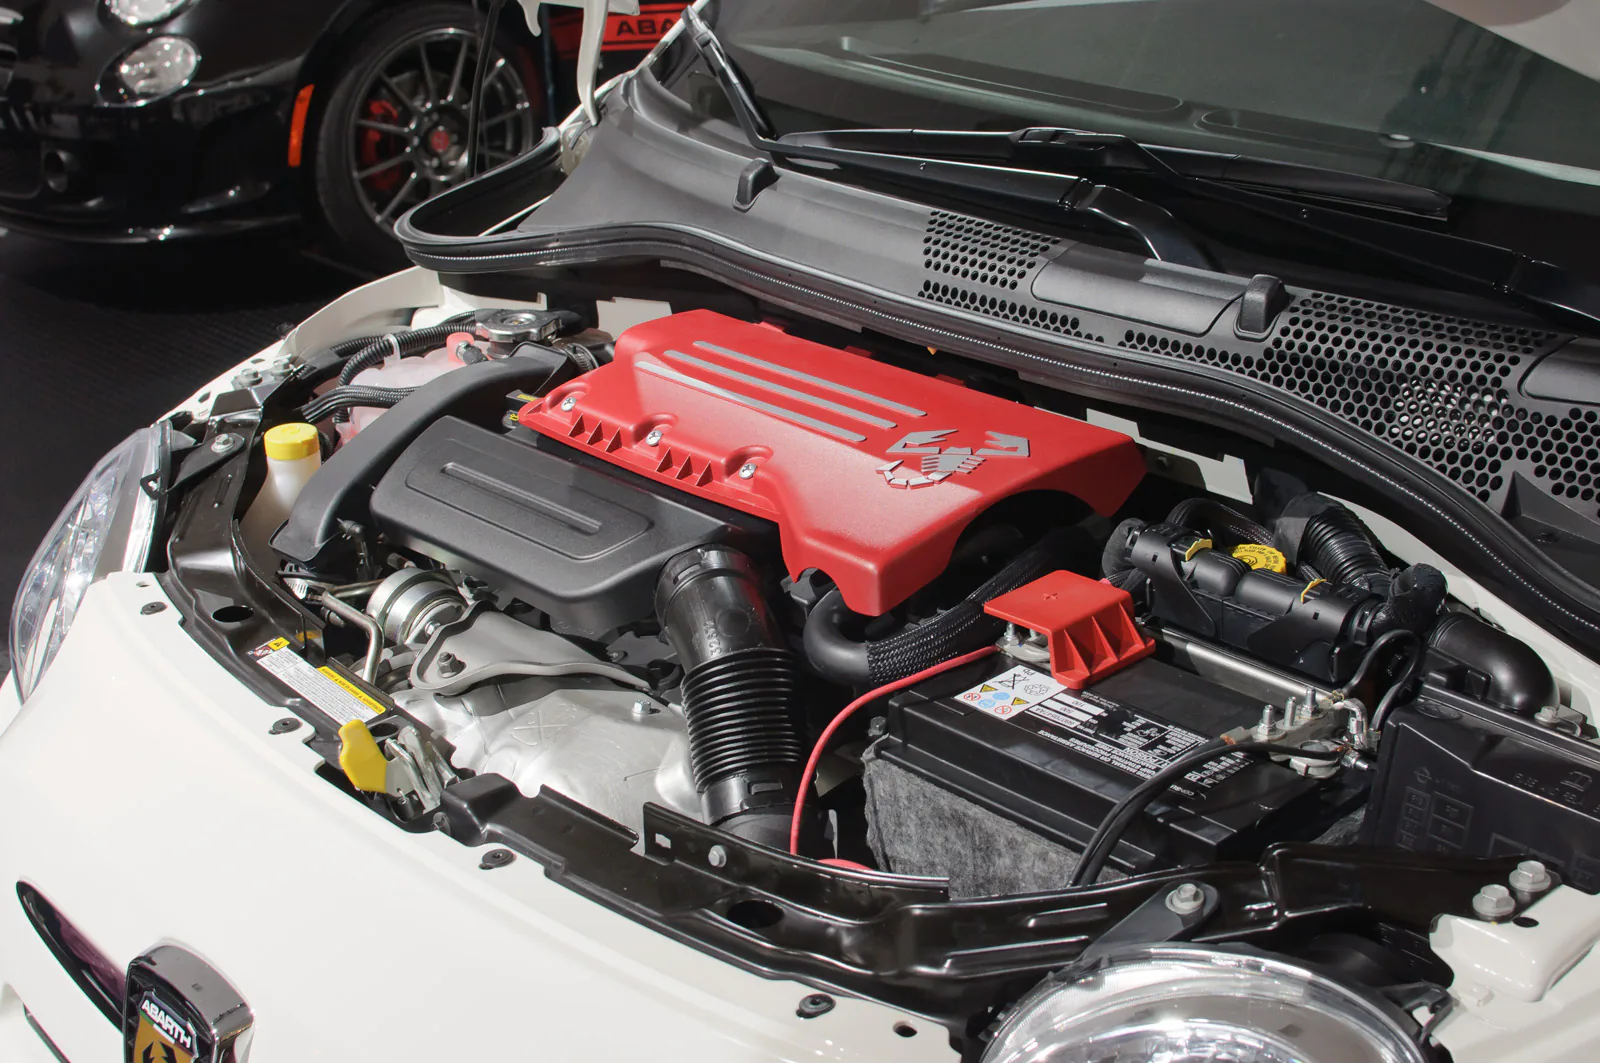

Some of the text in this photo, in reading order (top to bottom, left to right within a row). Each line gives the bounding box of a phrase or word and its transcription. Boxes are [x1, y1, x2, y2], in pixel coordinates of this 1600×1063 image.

[616, 18, 677, 37] ABA
[1023, 668, 1037, 677] Pb
[1036, 728, 1076, 747] ASSISTANCE
[1068, 736, 1157, 775] UMP STARTING PROCEDURES
[1073, 744, 1102, 758] SERVICE
[1110, 748, 1156, 770] MAINTENANCE
[1109, 759, 1137, 773] MANUAL
[141, 999, 192, 1049] ABARTH
